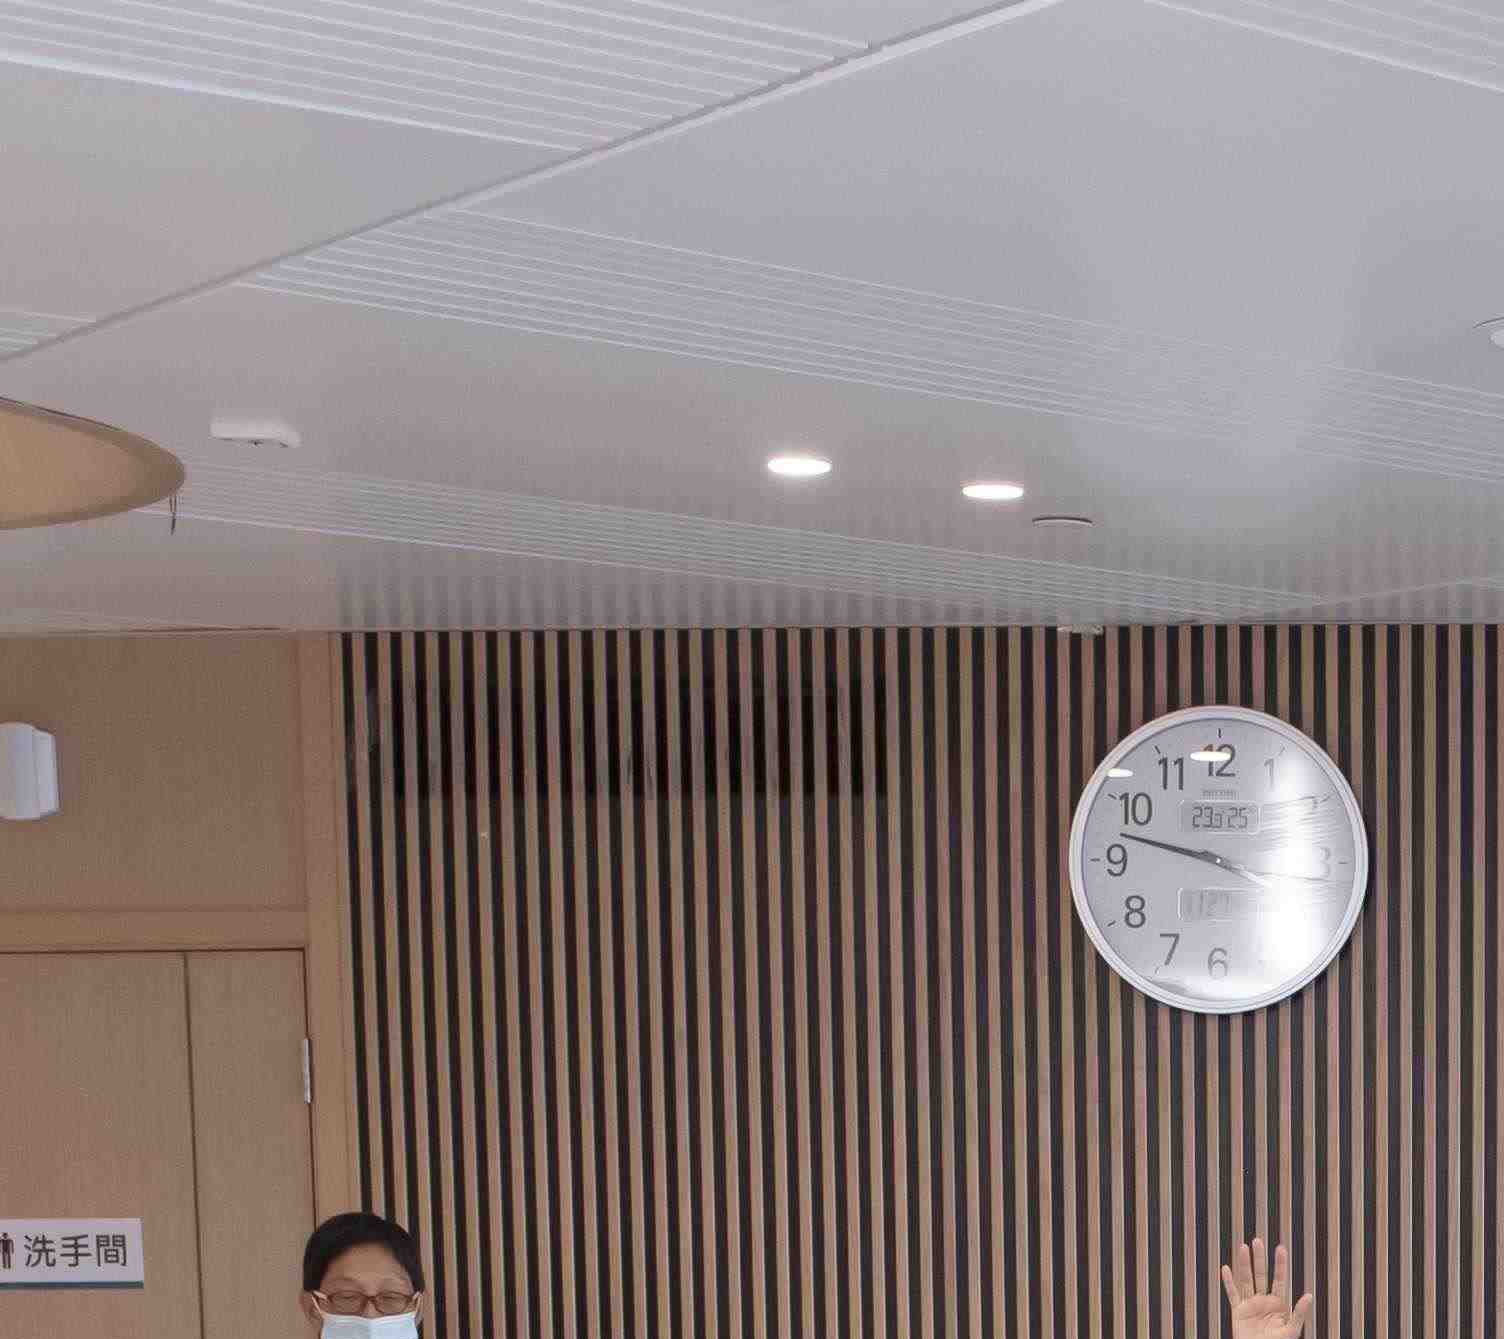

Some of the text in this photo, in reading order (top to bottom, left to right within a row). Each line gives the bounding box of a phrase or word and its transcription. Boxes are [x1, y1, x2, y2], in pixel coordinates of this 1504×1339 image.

[1157, 757, 1184, 790] 11
[1202, 744, 1236, 777] 12
[1119, 793, 1152, 826] 10
[1106, 844, 1128, 877] 9
[1124, 895, 1146, 928] 8
[1159, 933, 1180, 966] 7
[1207, 948, 1229, 979] 6
[23, 1233, 128, 1267] 洗手間
